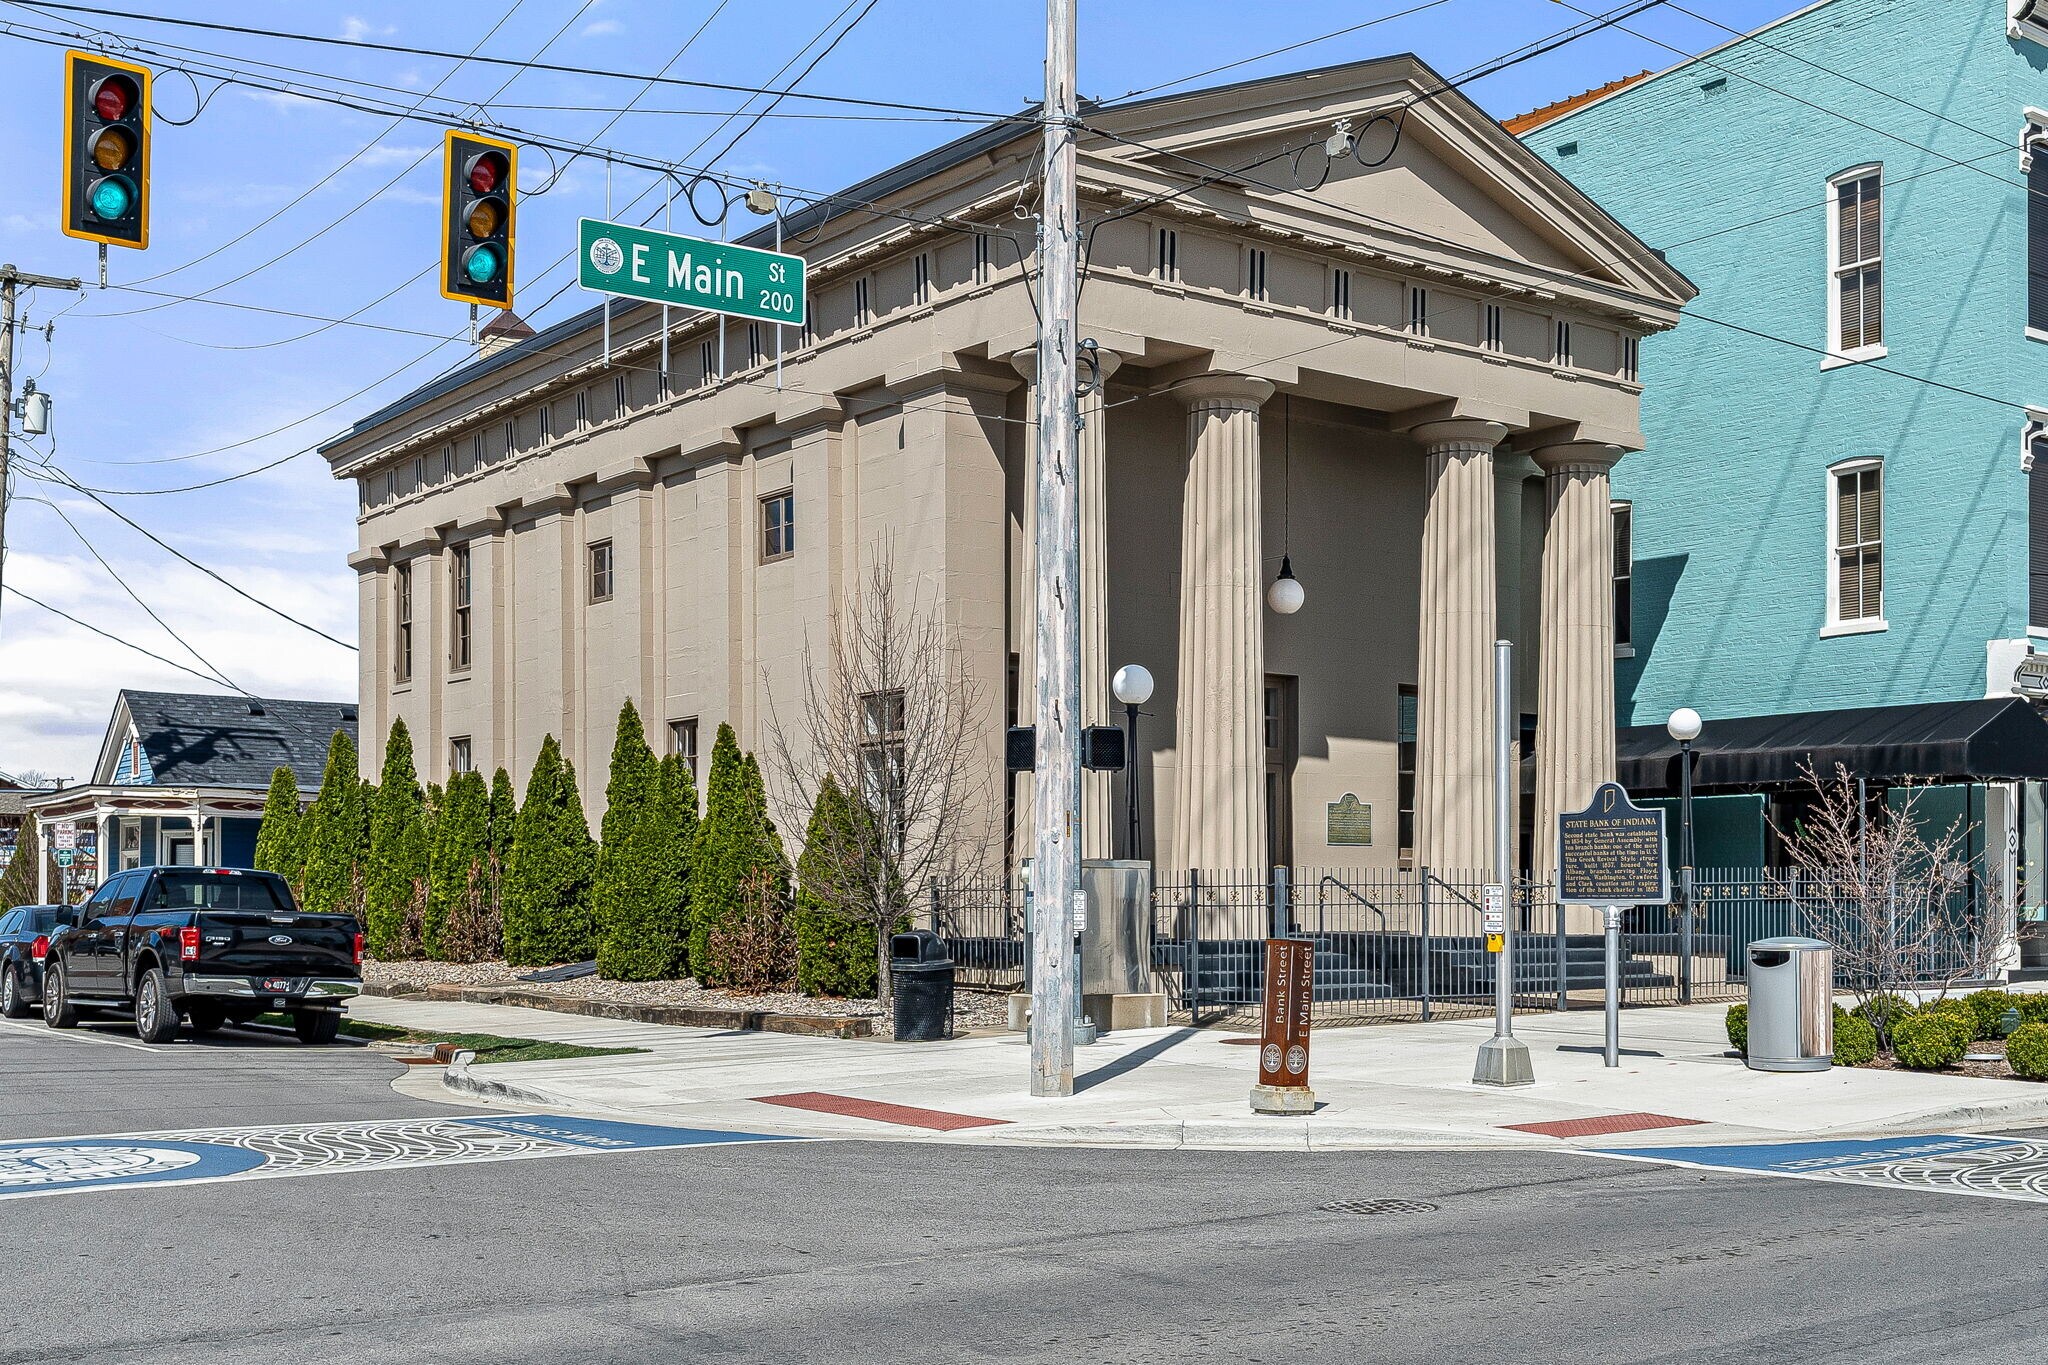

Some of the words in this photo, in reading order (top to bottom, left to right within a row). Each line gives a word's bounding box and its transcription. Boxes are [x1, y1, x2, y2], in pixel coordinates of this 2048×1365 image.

[632, 243, 650, 283] E
[668, 250, 743, 299] Main
[769, 262, 785, 284] St
[759, 290, 794, 313] 200
[1566, 820, 1588, 828] STATE
[1612, 818, 1621, 826] OF
[1624, 818, 1656, 826] INDIANA
[1277, 946, 1288, 986] Street
[1301, 946, 1312, 987] Street
[1275, 990, 1286, 1024] Bank
[1299, 991, 1309, 1024] Main
[1768, 1152, 1900, 1170] STREET
